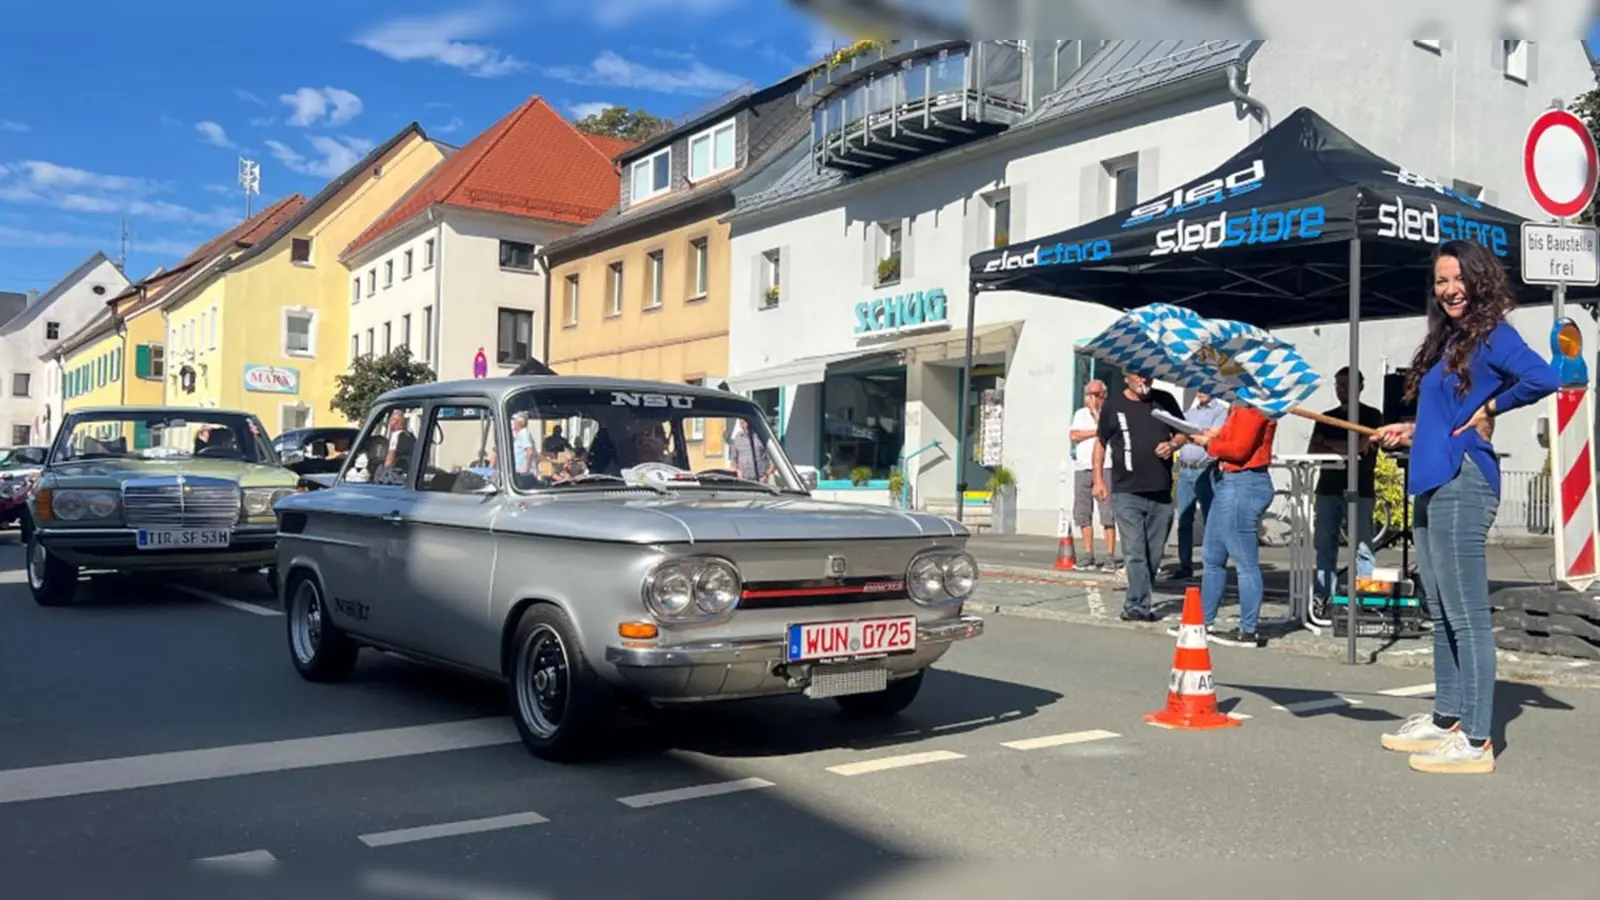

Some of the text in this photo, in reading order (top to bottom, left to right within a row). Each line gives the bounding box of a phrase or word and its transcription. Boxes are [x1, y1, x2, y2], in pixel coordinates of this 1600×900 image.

[1150, 205, 1325, 256] sledstore
[1528, 233, 1593, 252] bis Baustelle
[1550, 258, 1574, 276] frei
[854, 287, 947, 333] SCHUG
[611, 392, 695, 408] NSU
[181, 531, 197, 544] SF
[201, 530, 227, 544] 53H
[806, 621, 911, 655] WUN 0725
